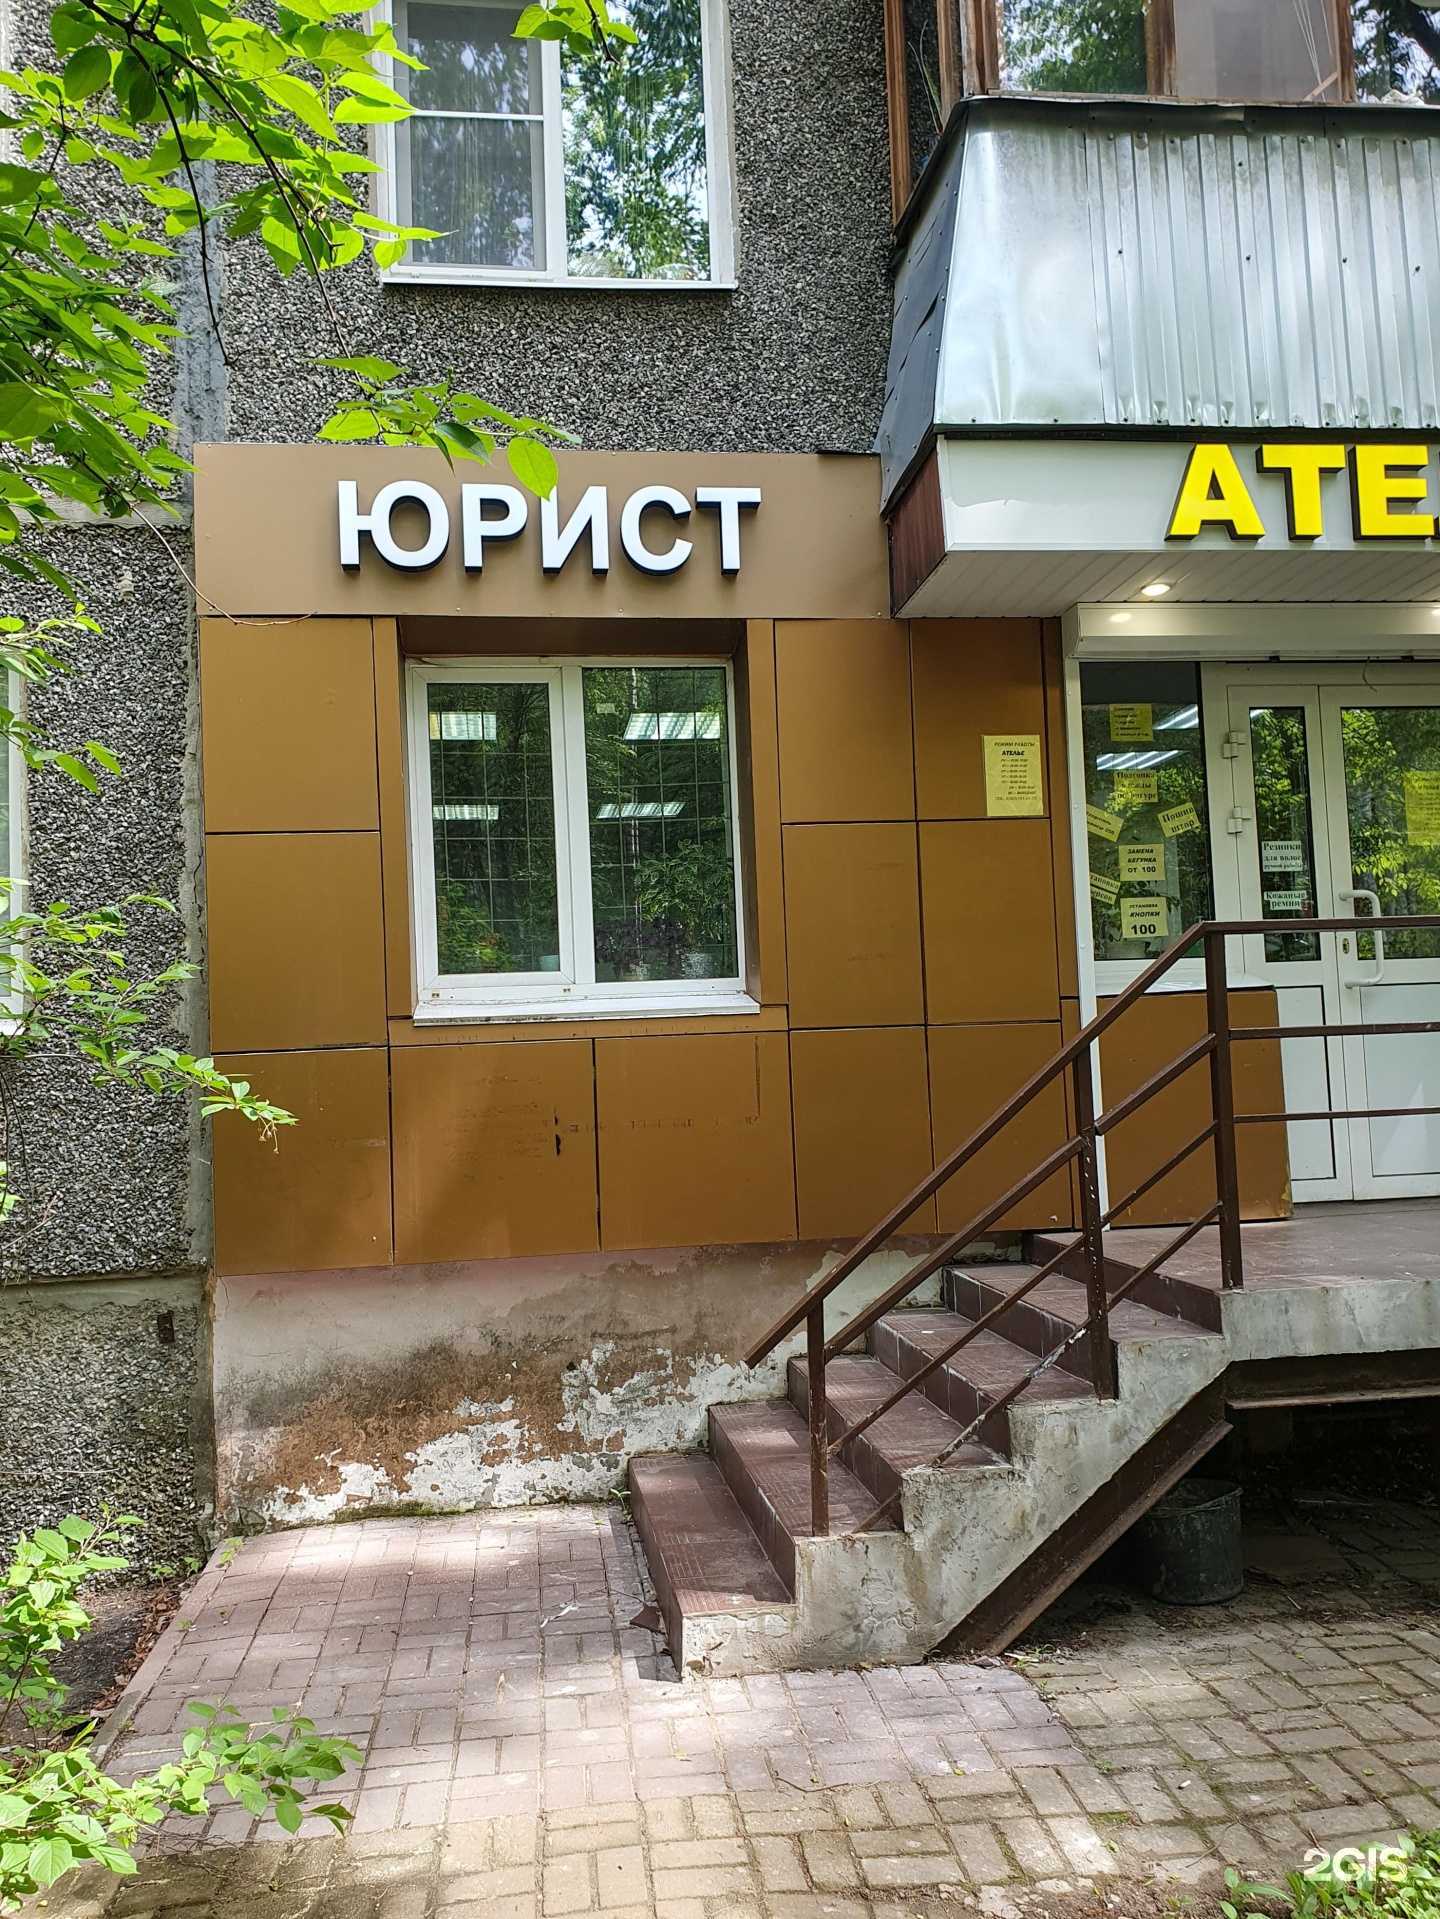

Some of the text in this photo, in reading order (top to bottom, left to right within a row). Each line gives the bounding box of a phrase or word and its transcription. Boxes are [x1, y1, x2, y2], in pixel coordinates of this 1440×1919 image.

[1165, 443, 1440, 541] АТЕ
[337, 480, 762, 575] ЮРИСТ
[1162, 806, 1194, 824] Пошив
[1171, 819, 1195, 834] штор
[1263, 842, 1301, 851] Резинки
[1131, 924, 1157, 935] 100
